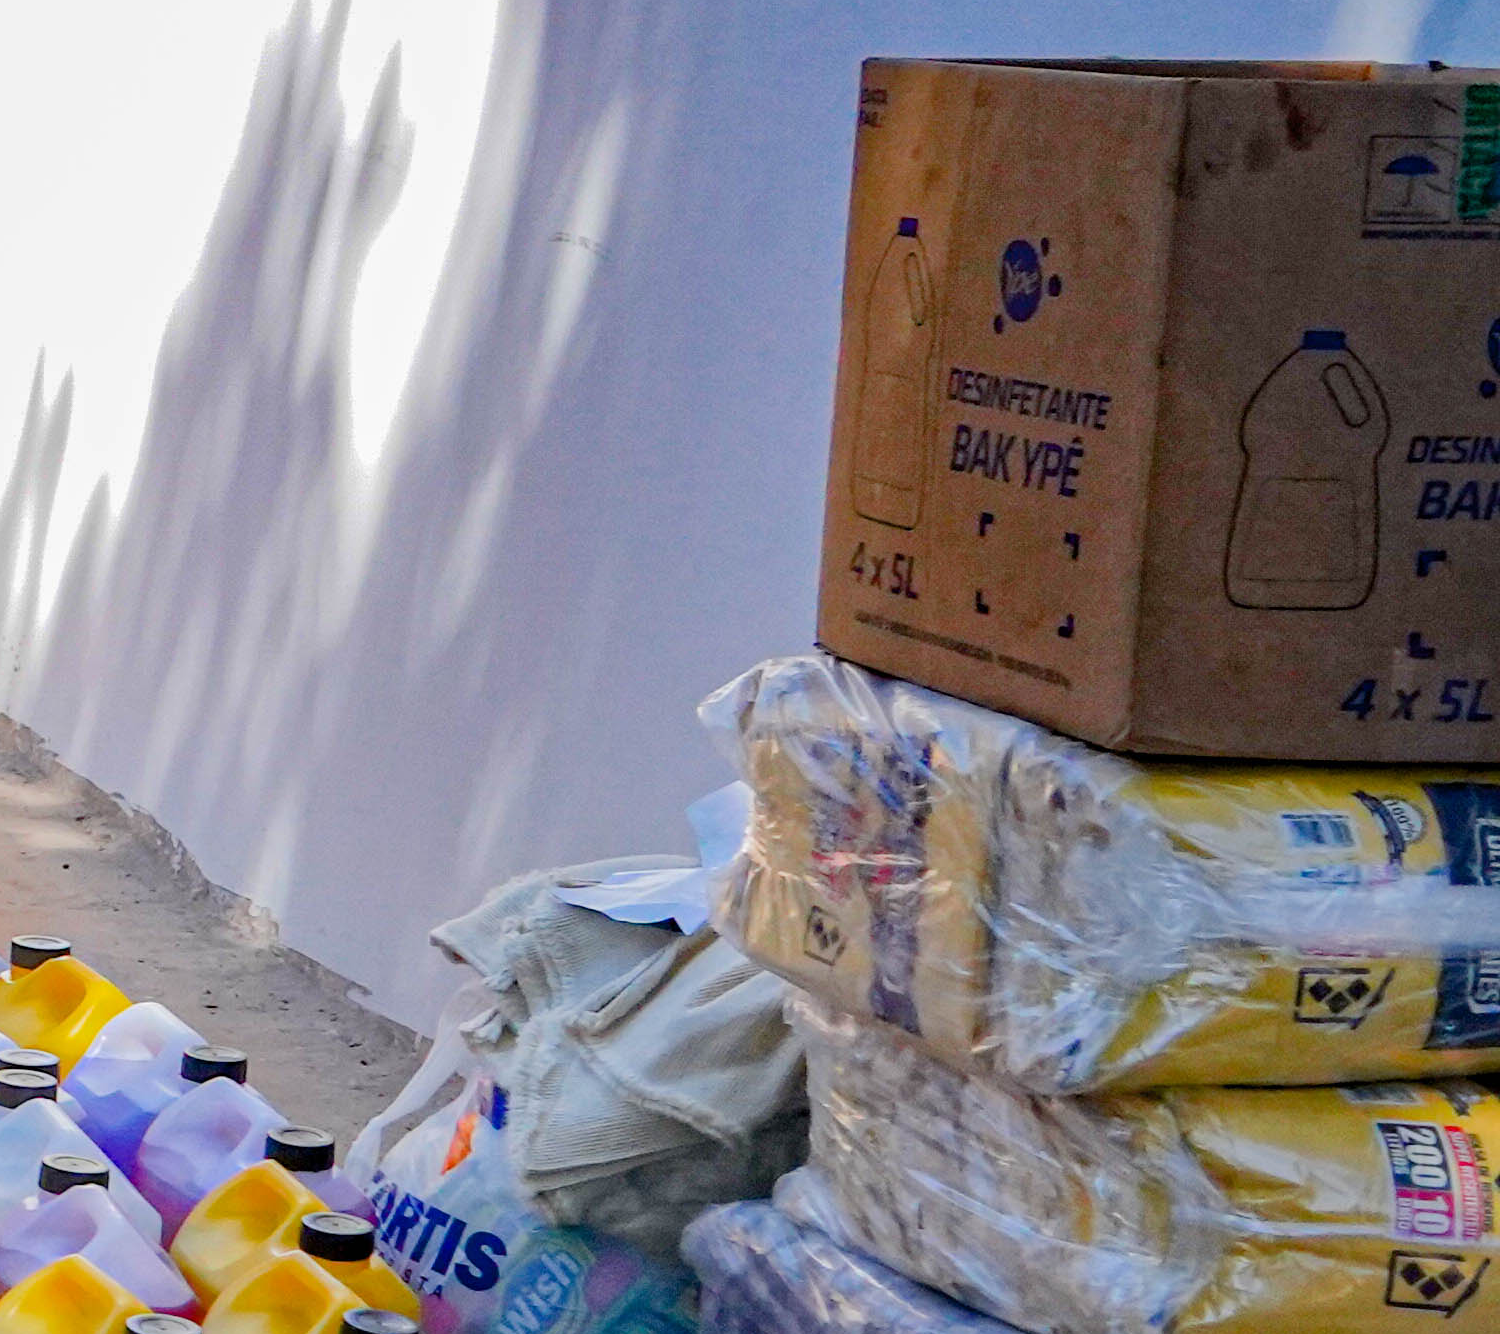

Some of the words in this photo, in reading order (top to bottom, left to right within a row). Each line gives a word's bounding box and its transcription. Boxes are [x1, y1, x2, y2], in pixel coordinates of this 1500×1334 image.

[948, 367, 1112, 432] DESINFETANTE
[950, 424, 1017, 484] BAK
[1022, 436, 1085, 498] YPÊ
[850, 542, 866, 578] 4
[1341, 678, 1378, 721] 4
[1432, 679, 1494, 723] 5L
[1387, 798, 1417, 840] 100%
[1397, 1126, 1449, 1189] 200
[371, 1170, 507, 1291] ORTIS
[1411, 1196, 1451, 1235] 10
